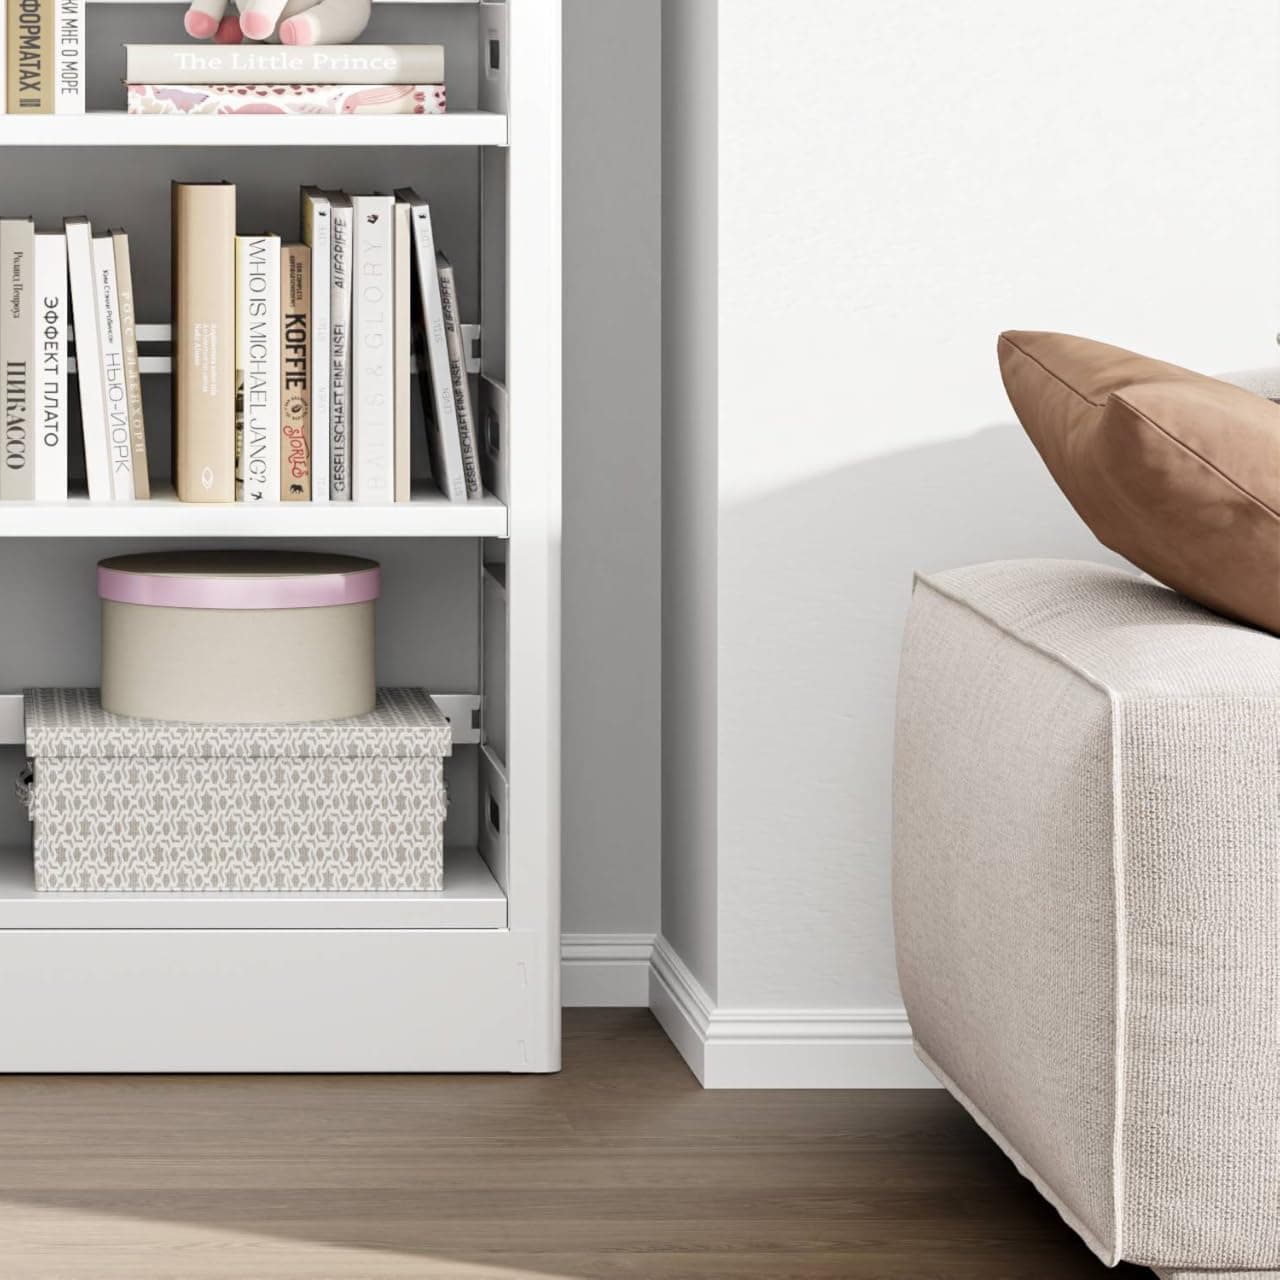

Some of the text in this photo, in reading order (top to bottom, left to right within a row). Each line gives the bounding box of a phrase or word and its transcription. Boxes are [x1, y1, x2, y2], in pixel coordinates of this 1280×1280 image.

[61, 18, 78, 45] МНЕ
[174, 53, 397, 70] The Little Prince
[61, 62, 78, 94] МОРЕ
[44, 296, 59, 447] ЭФФЕКТ ПЛАТО
[249, 240, 266, 484] WHO IS MICHAEL JANG?
[285, 314, 306, 390] KOFFIE
[6, 361, 26, 470] ПИКАССО
[106, 353, 129, 473] НЬЮ-ЙОРК
